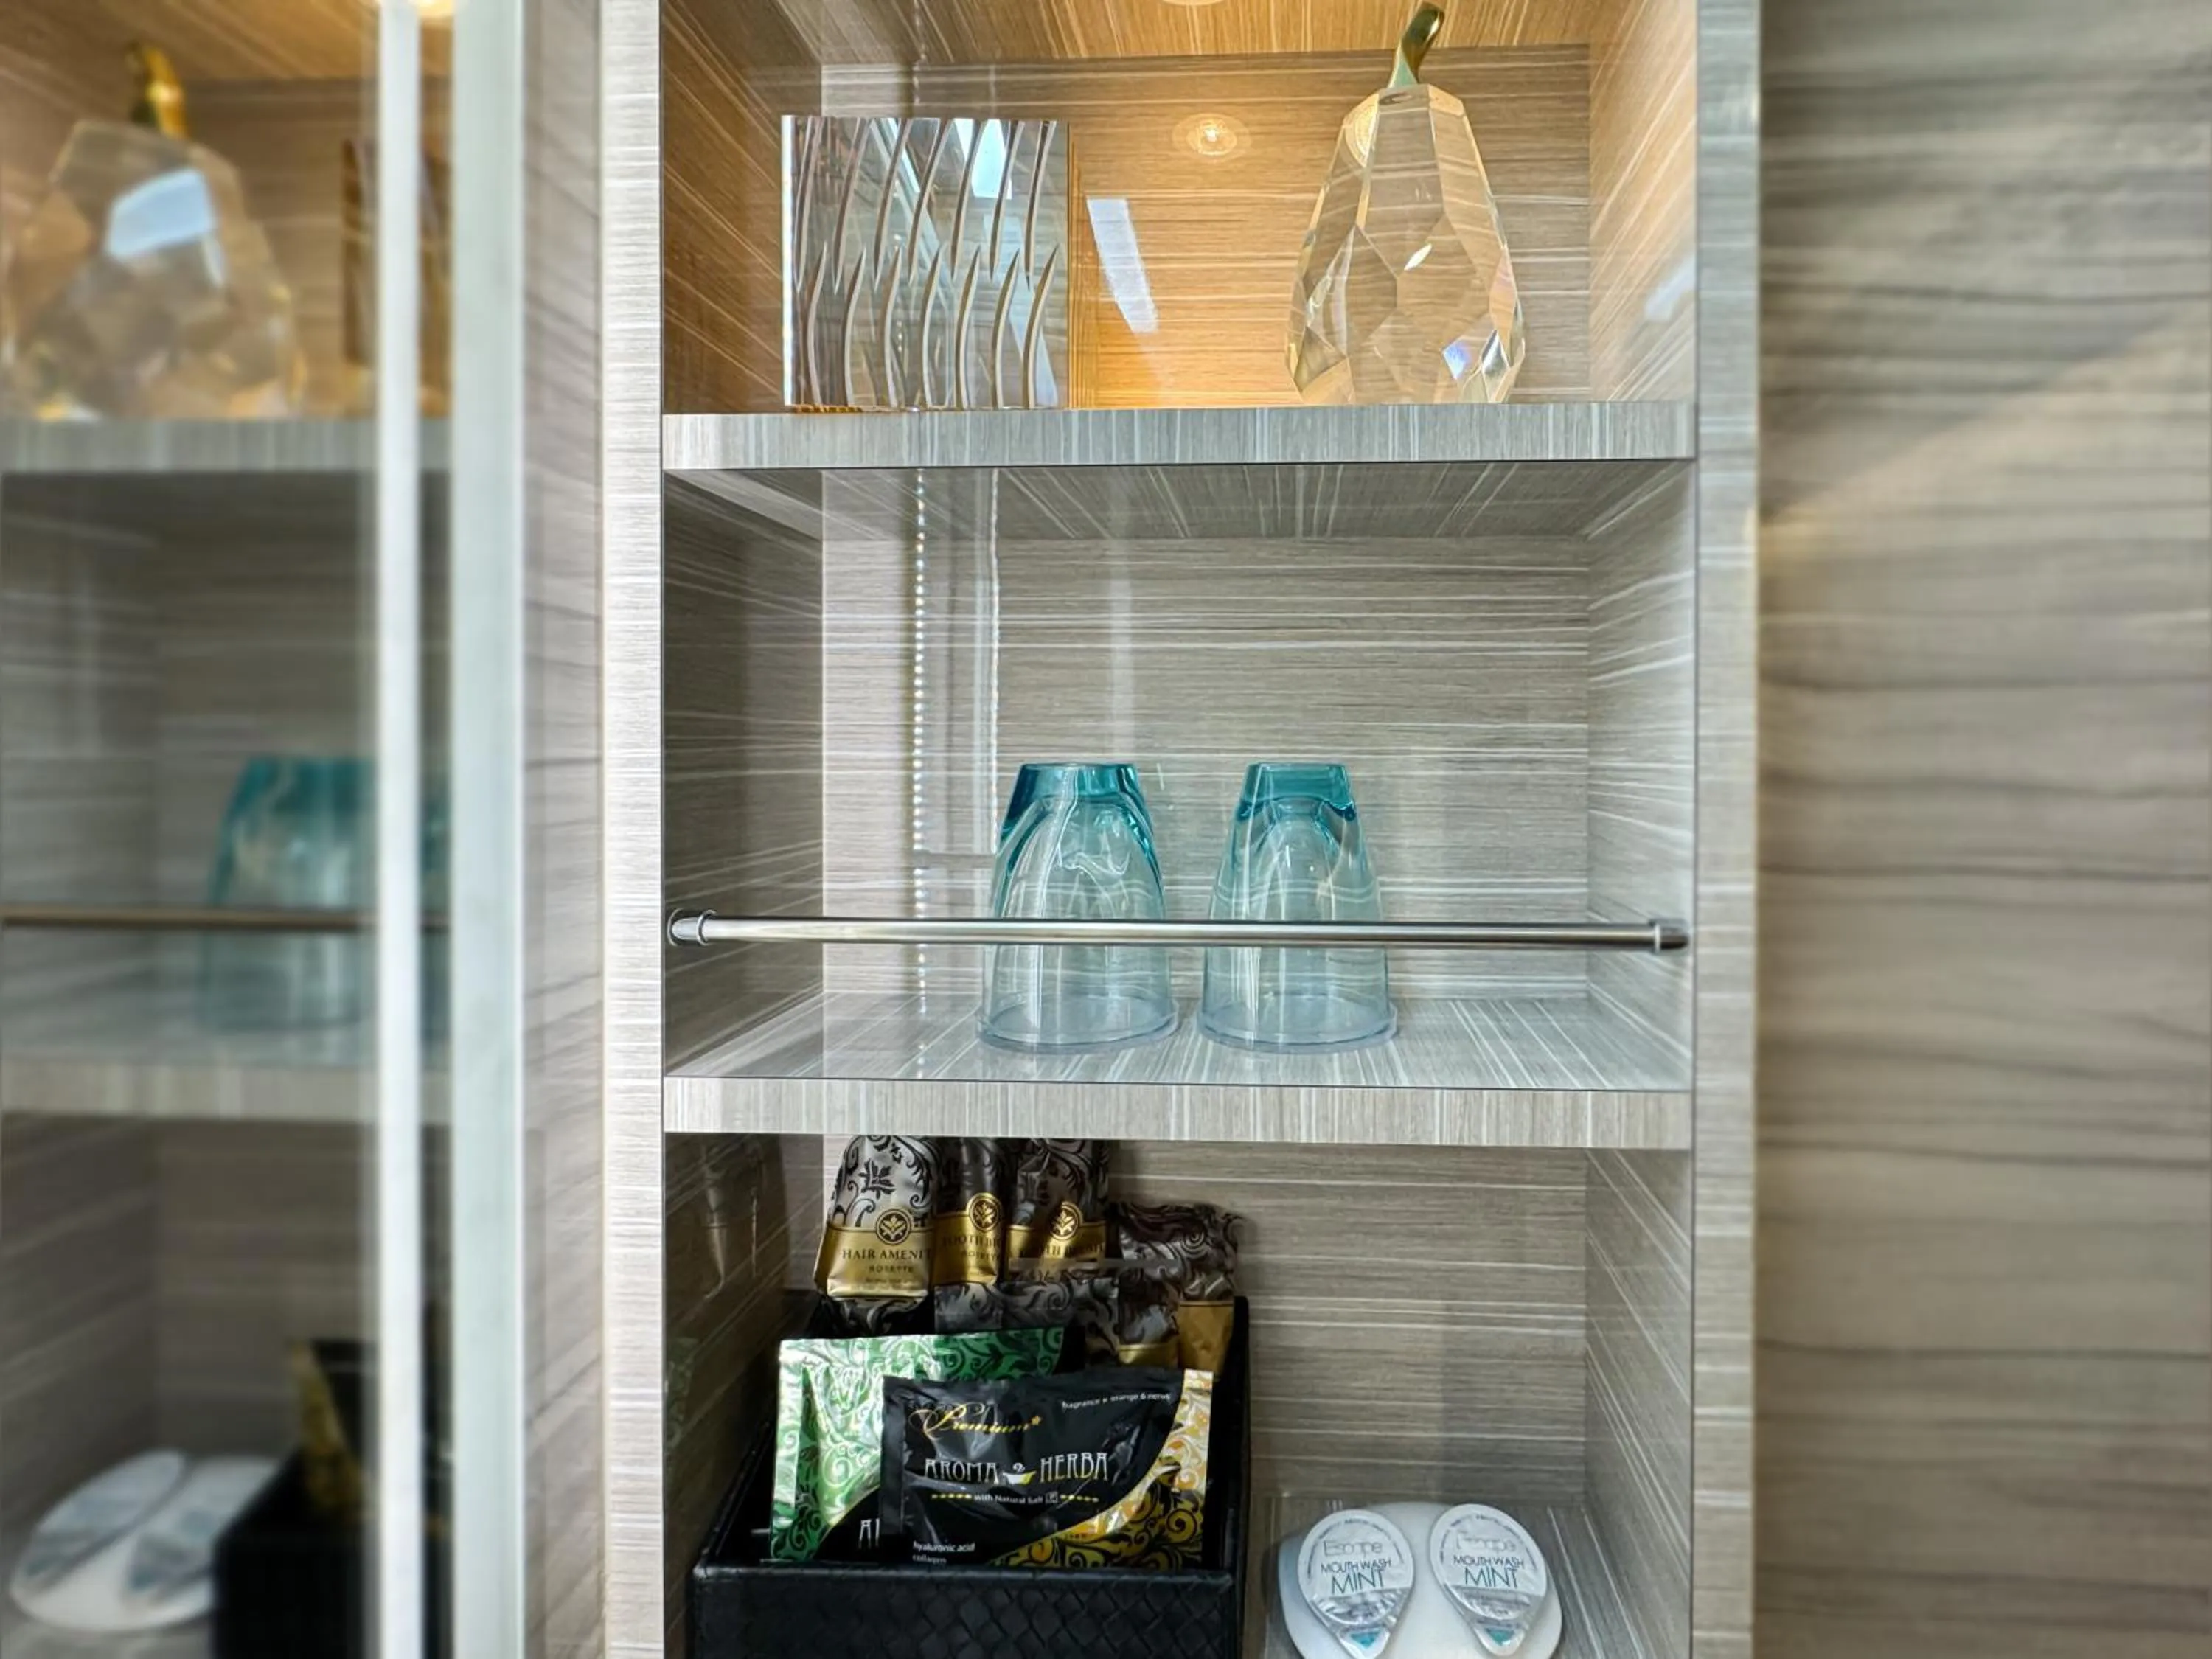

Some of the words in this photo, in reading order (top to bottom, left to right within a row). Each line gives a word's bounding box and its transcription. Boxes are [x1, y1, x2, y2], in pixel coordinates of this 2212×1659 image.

[842, 1249, 876, 1260] HAIR
[924, 1458, 1000, 1484] AROMA
[1039, 1452, 1109, 1483] HERBA
[1332, 1568, 1384, 1595] MINT
[1465, 1566, 1518, 1589] MINT
